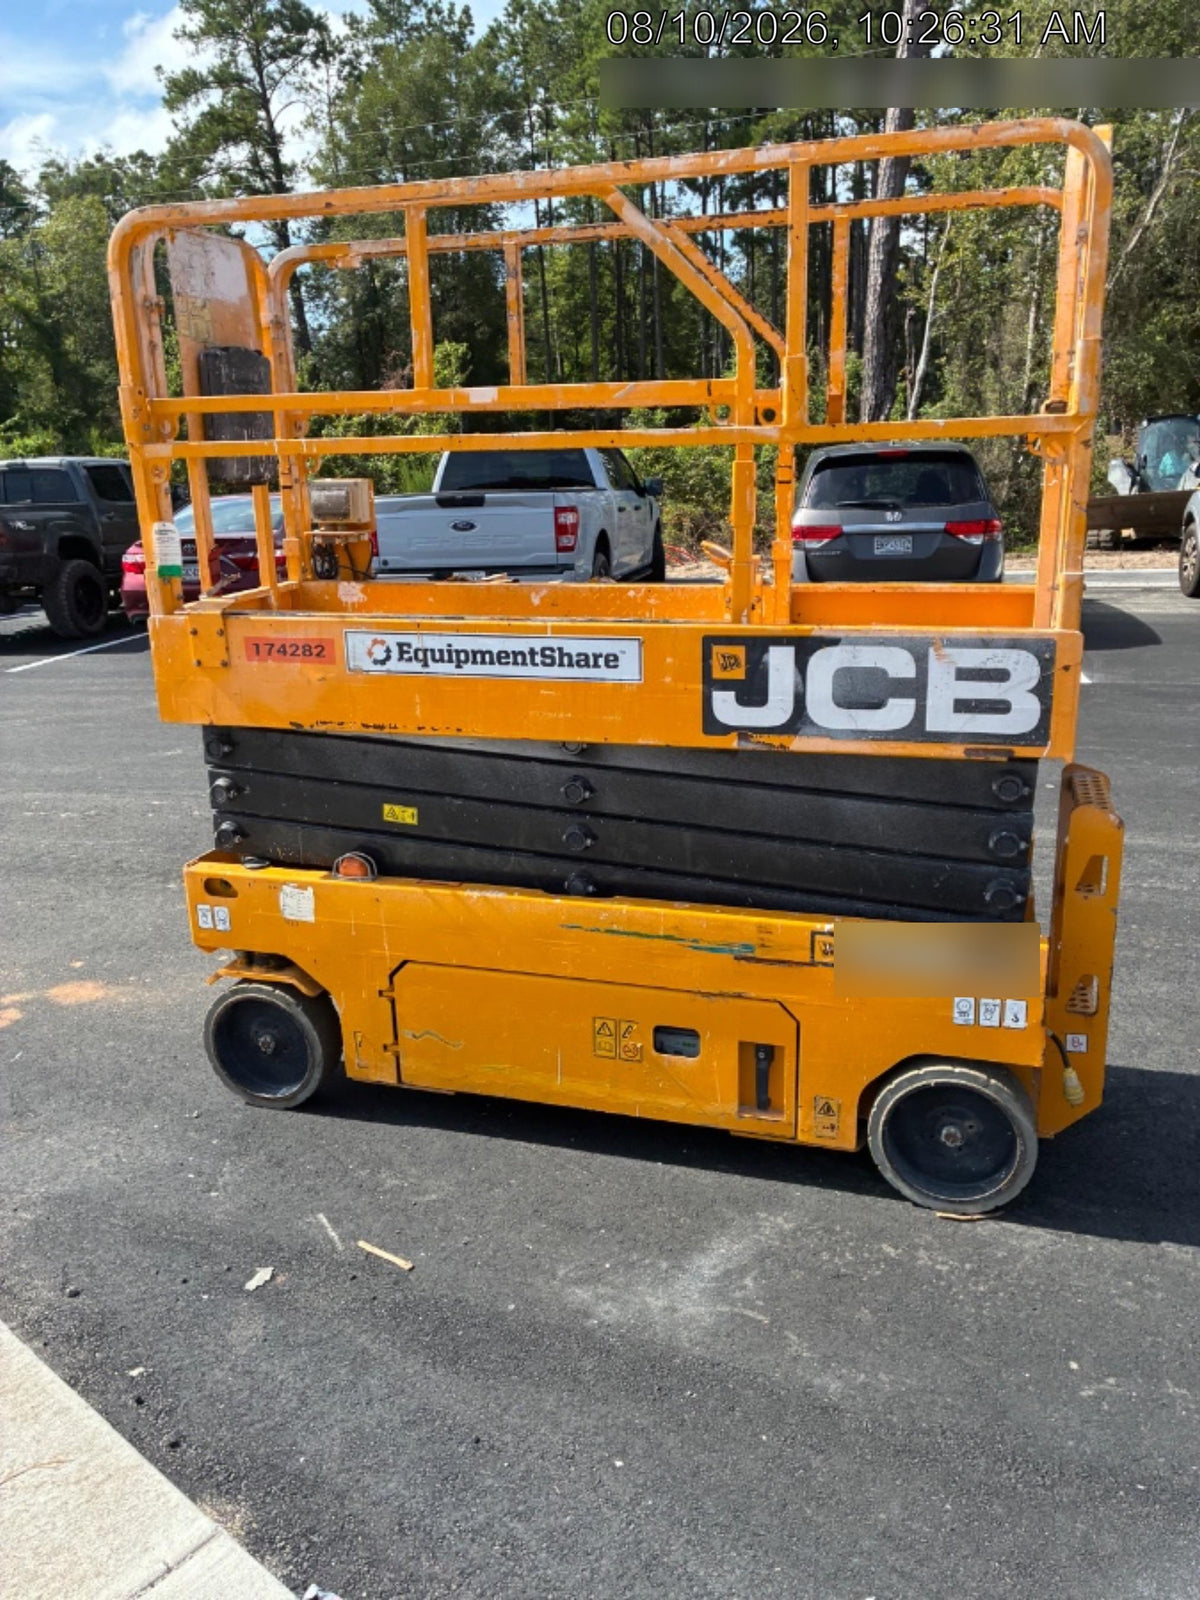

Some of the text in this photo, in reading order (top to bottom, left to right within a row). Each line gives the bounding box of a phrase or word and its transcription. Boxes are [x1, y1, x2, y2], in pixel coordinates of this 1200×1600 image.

[251, 642, 326, 659] 174282
[396, 641, 620, 669] EquipmentShare
[711, 645, 1042, 735] JCB
